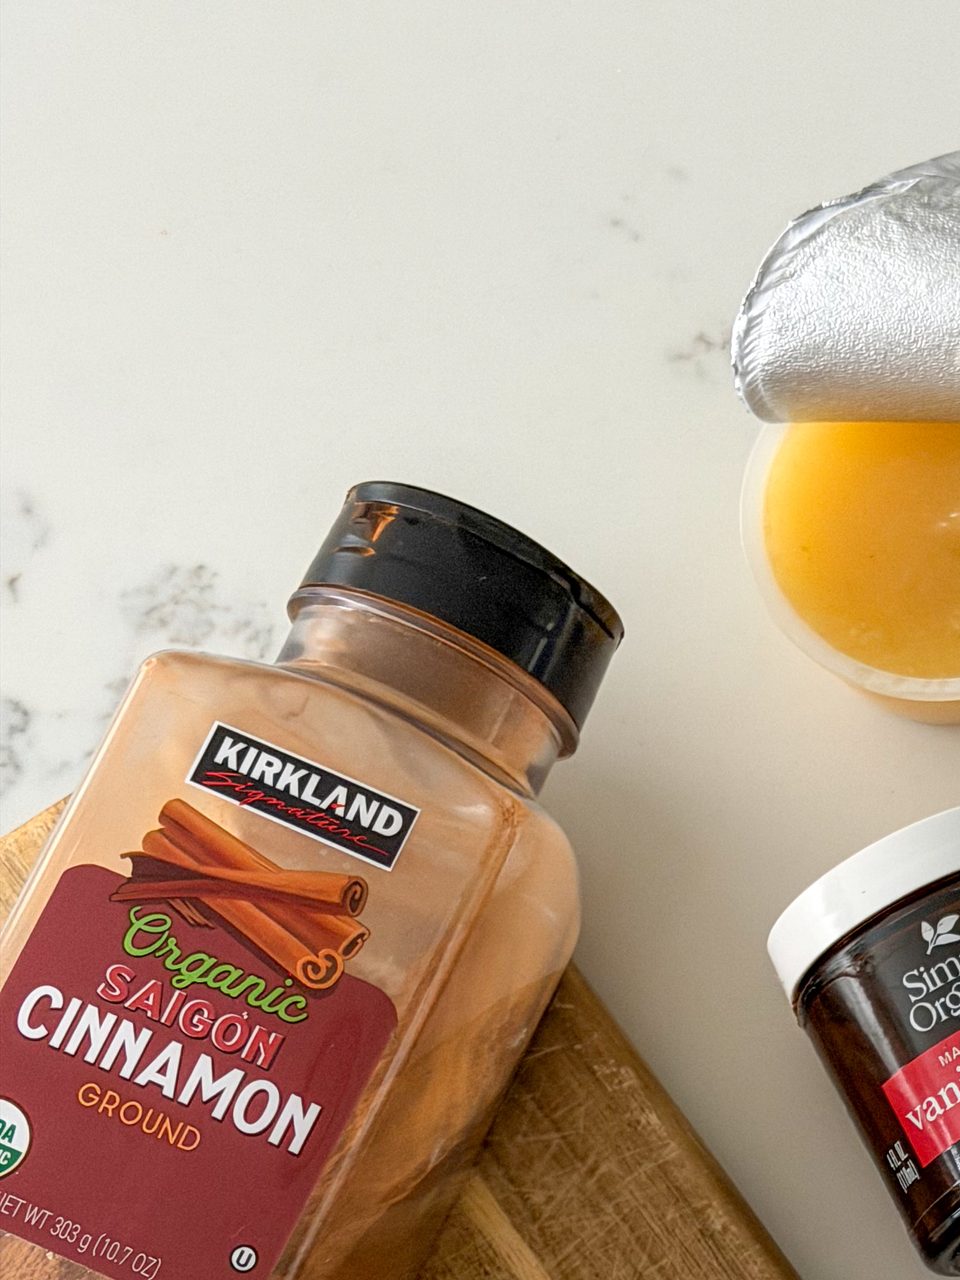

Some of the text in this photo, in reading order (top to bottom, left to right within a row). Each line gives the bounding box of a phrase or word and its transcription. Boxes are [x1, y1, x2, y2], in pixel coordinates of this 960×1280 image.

[201, 771, 389, 857] Signature
[213, 735, 403, 838] KIRKLAND
[122, 905, 310, 1025] Organic
[16, 984, 322, 1155] CINNAMON
[77, 1082, 201, 1152] GROUND
[24, 1203, 54, 1230] WT
[50, 1216, 81, 1243] 303
[77, 1234, 92, 1253] g
[92, 1232, 133, 1265] (10.7
[131, 1252, 162, 1280] OZ)
